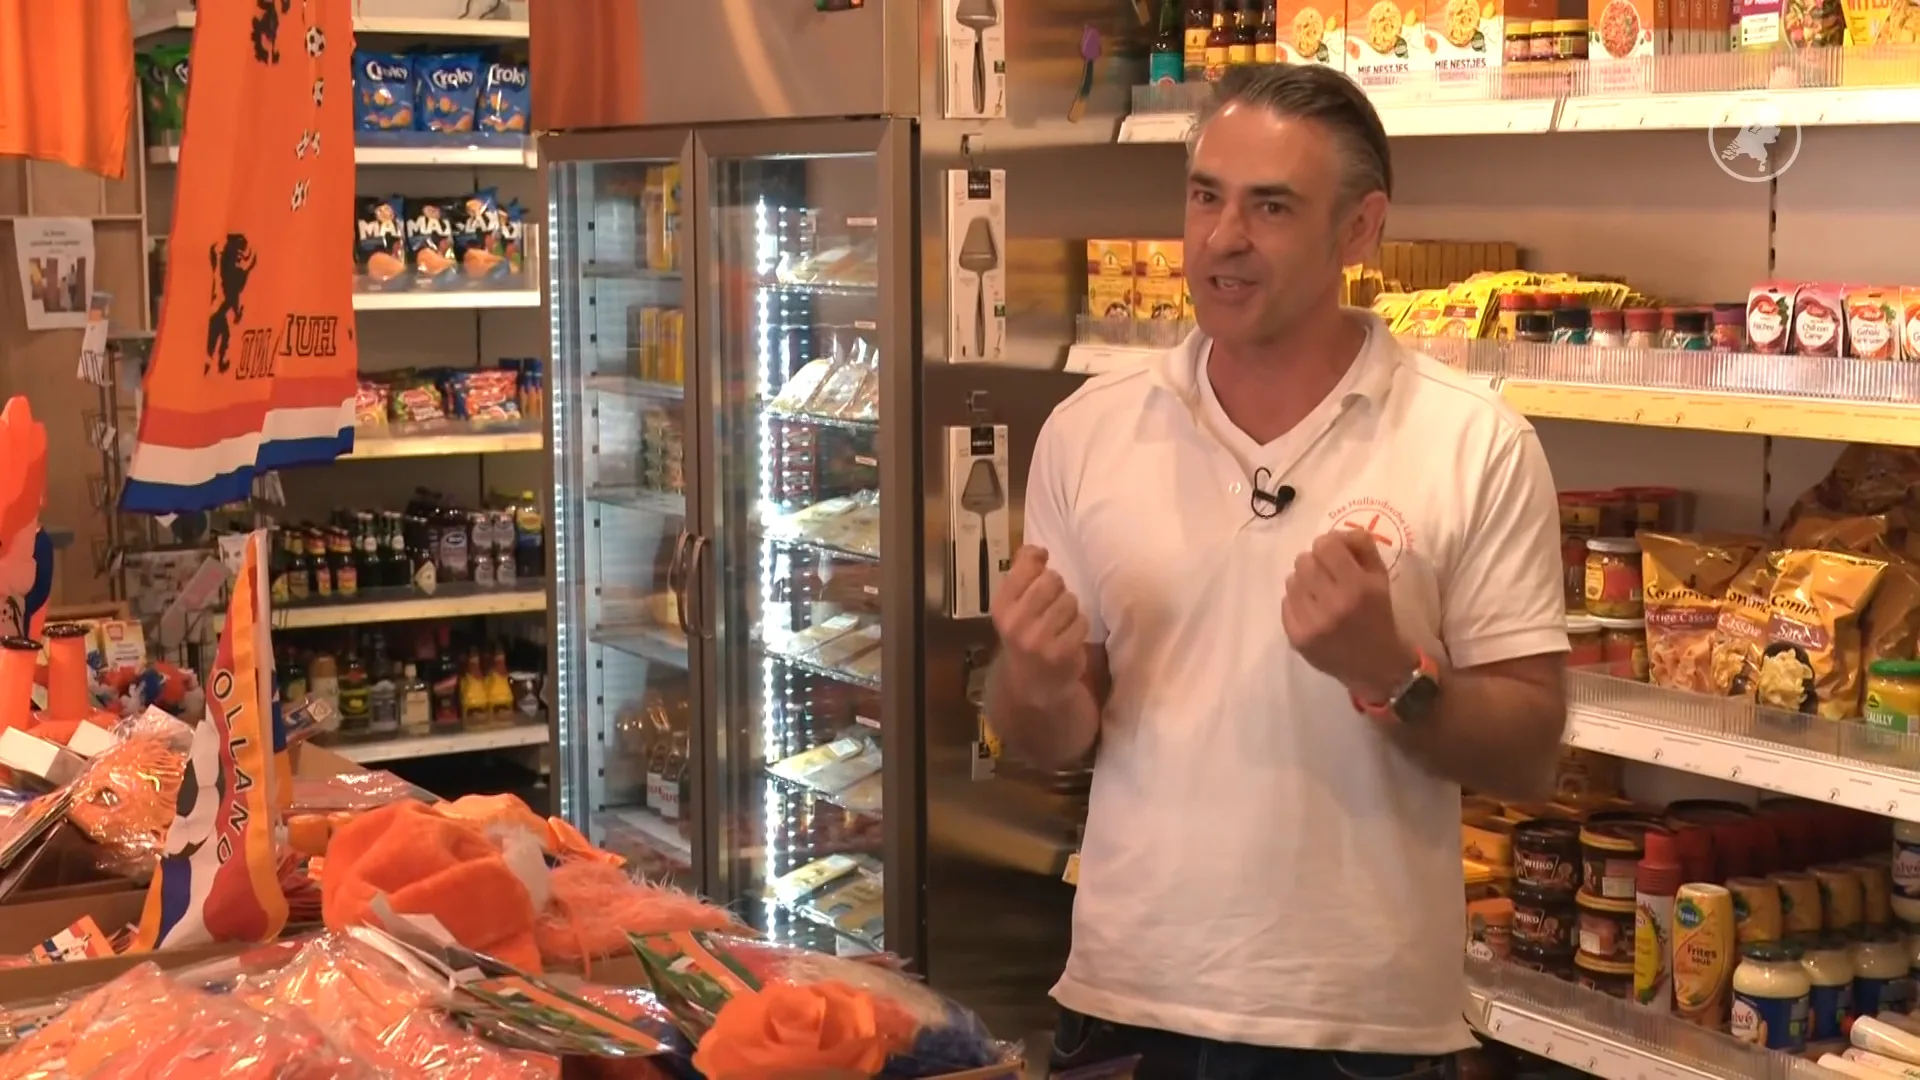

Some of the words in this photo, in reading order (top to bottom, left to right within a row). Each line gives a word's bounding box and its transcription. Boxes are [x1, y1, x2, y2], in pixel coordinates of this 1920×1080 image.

[1373, 63, 1408, 74] NESTJES
[1435, 59, 1448, 70] MIE
[1450, 58, 1486, 69] NESTJES
[433, 68, 473, 88] Croky
[488, 64, 526, 86] Croky
[1687, 943, 1717, 958] Frites
